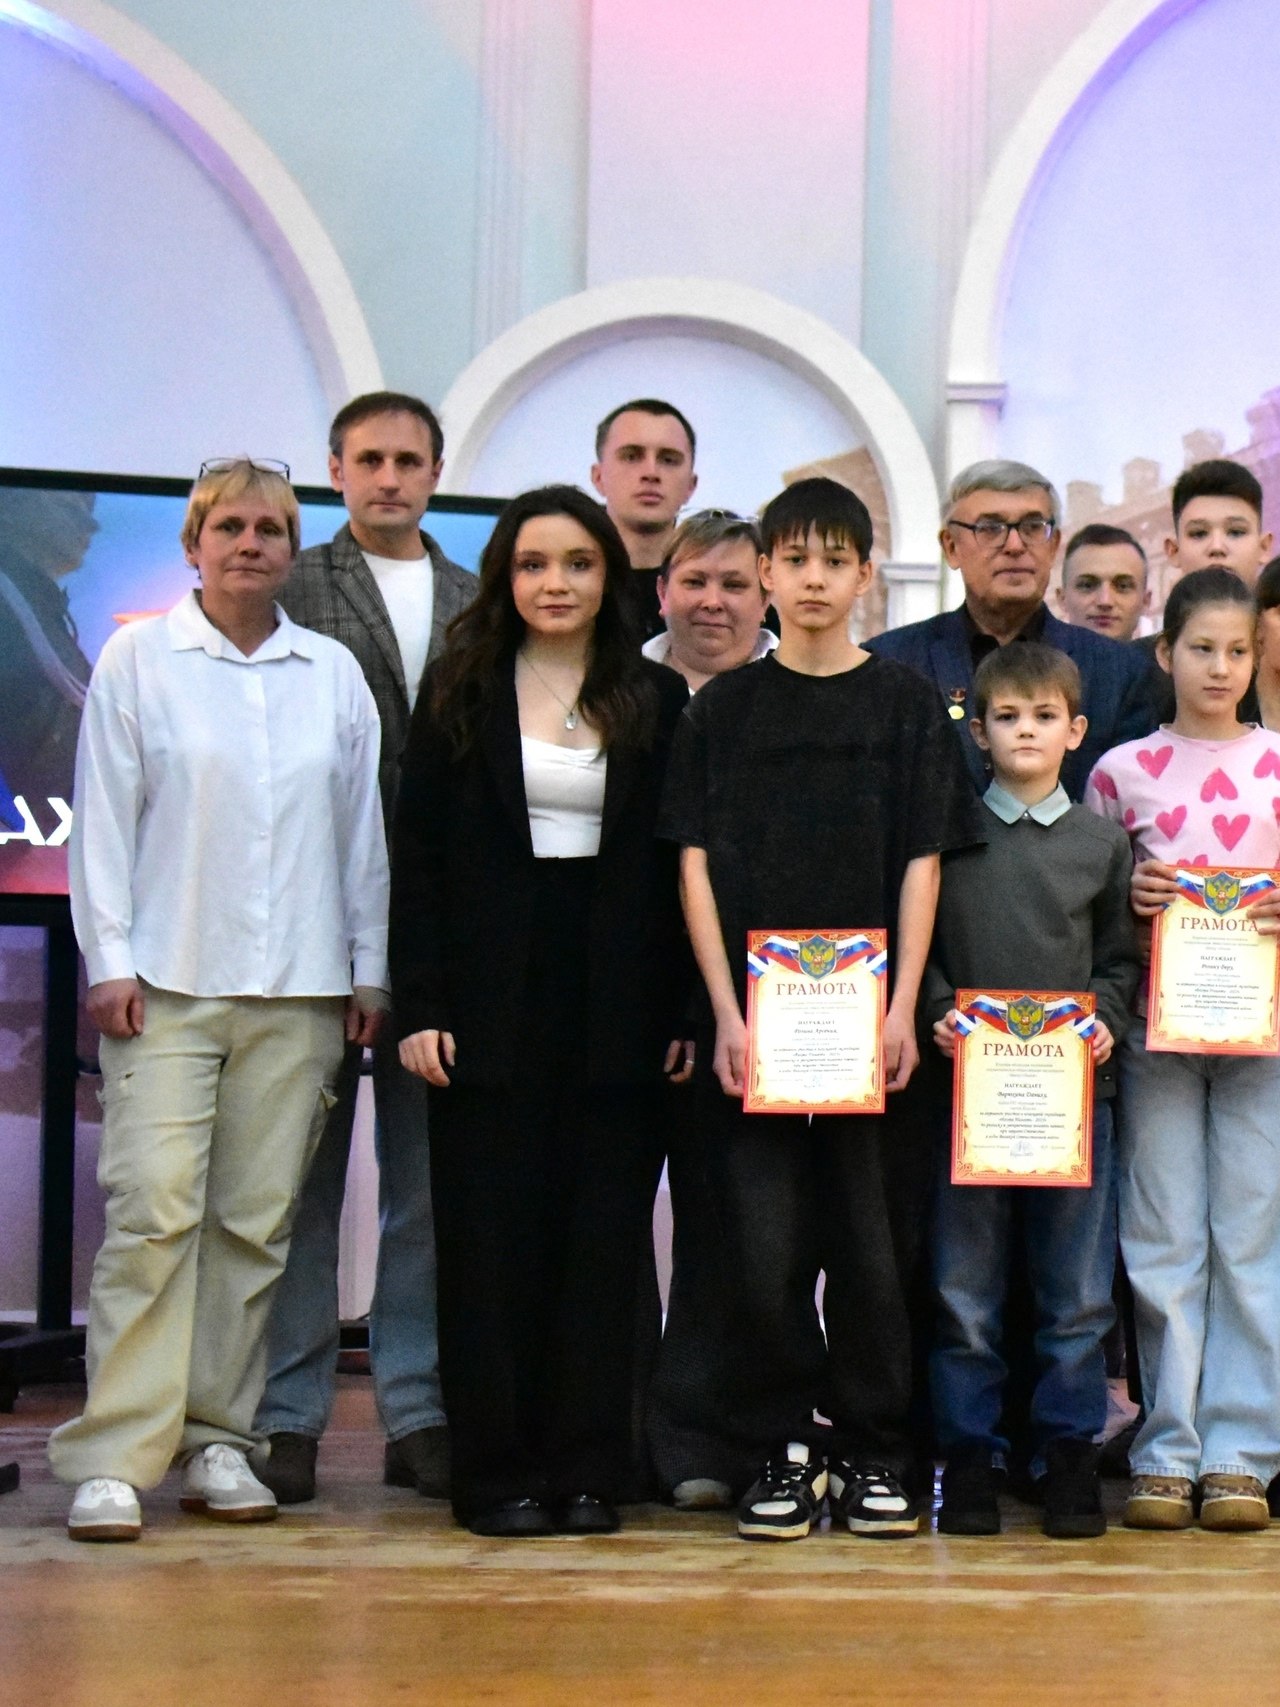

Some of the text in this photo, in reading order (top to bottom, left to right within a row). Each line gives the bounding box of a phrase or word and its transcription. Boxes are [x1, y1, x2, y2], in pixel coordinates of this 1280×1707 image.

[1180, 917, 1259, 932] ГРАМОТА
[776, 982, 857, 996] ГРАМОТА
[983, 1043, 1065, 1058] ГРАМОТА
